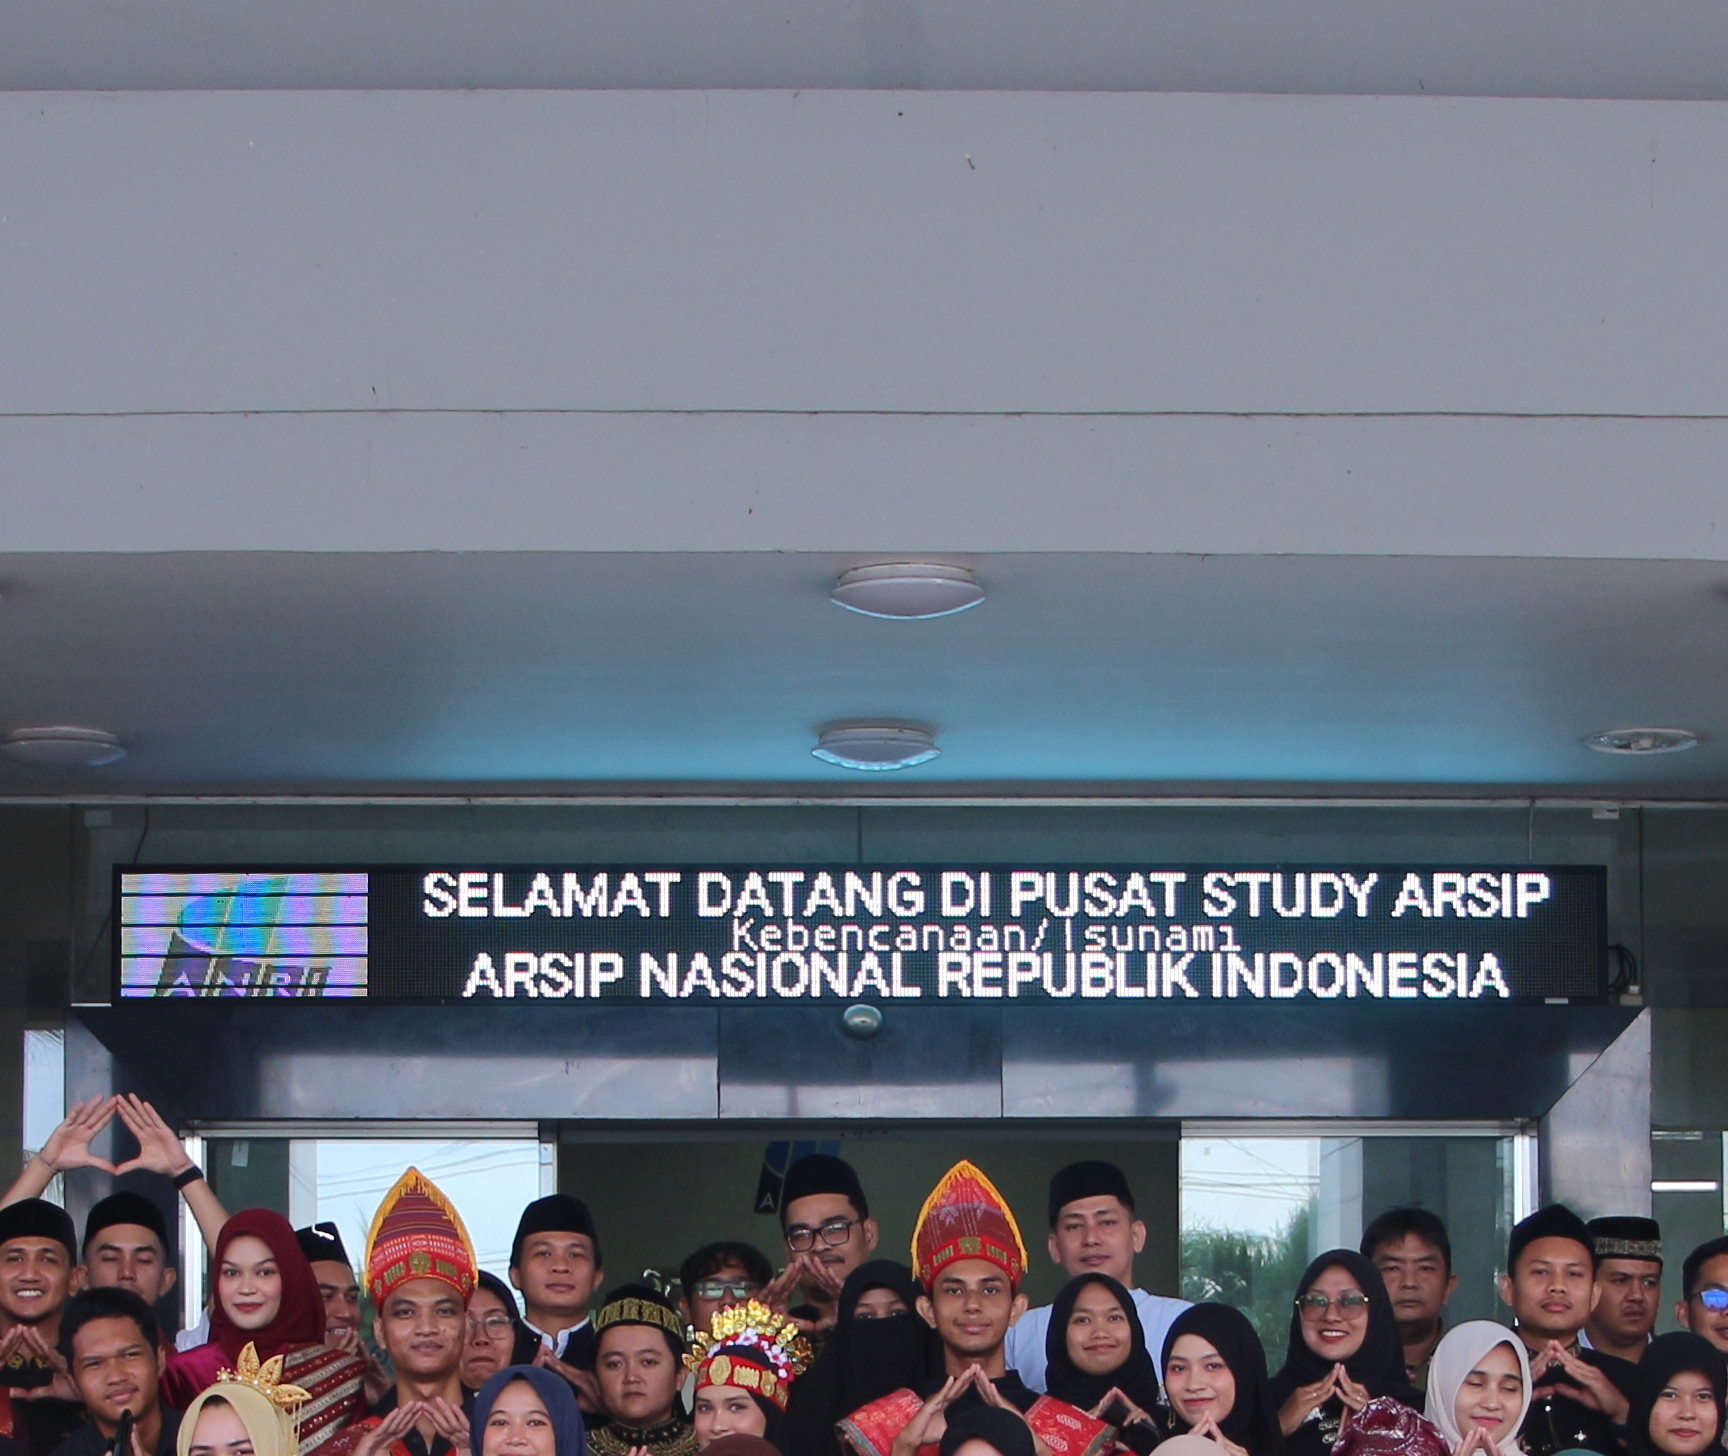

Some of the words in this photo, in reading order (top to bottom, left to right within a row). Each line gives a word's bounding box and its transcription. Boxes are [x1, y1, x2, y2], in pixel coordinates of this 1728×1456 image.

[422, 871, 681, 917] SELAMAT
[697, 871, 925, 917] DATANG
[940, 871, 991, 917] DI
[1010, 871, 1187, 917] PUSAT
[1202, 871, 1378, 917] STUDY
[1391, 871, 1551, 917] ARSIP
[461, 952, 623, 998] ARSIP
[639, 952, 921, 998] NASIONAL
[937, 952, 1199, 998] REPUBLIK
[1211, 952, 1510, 998] INDONESIA
